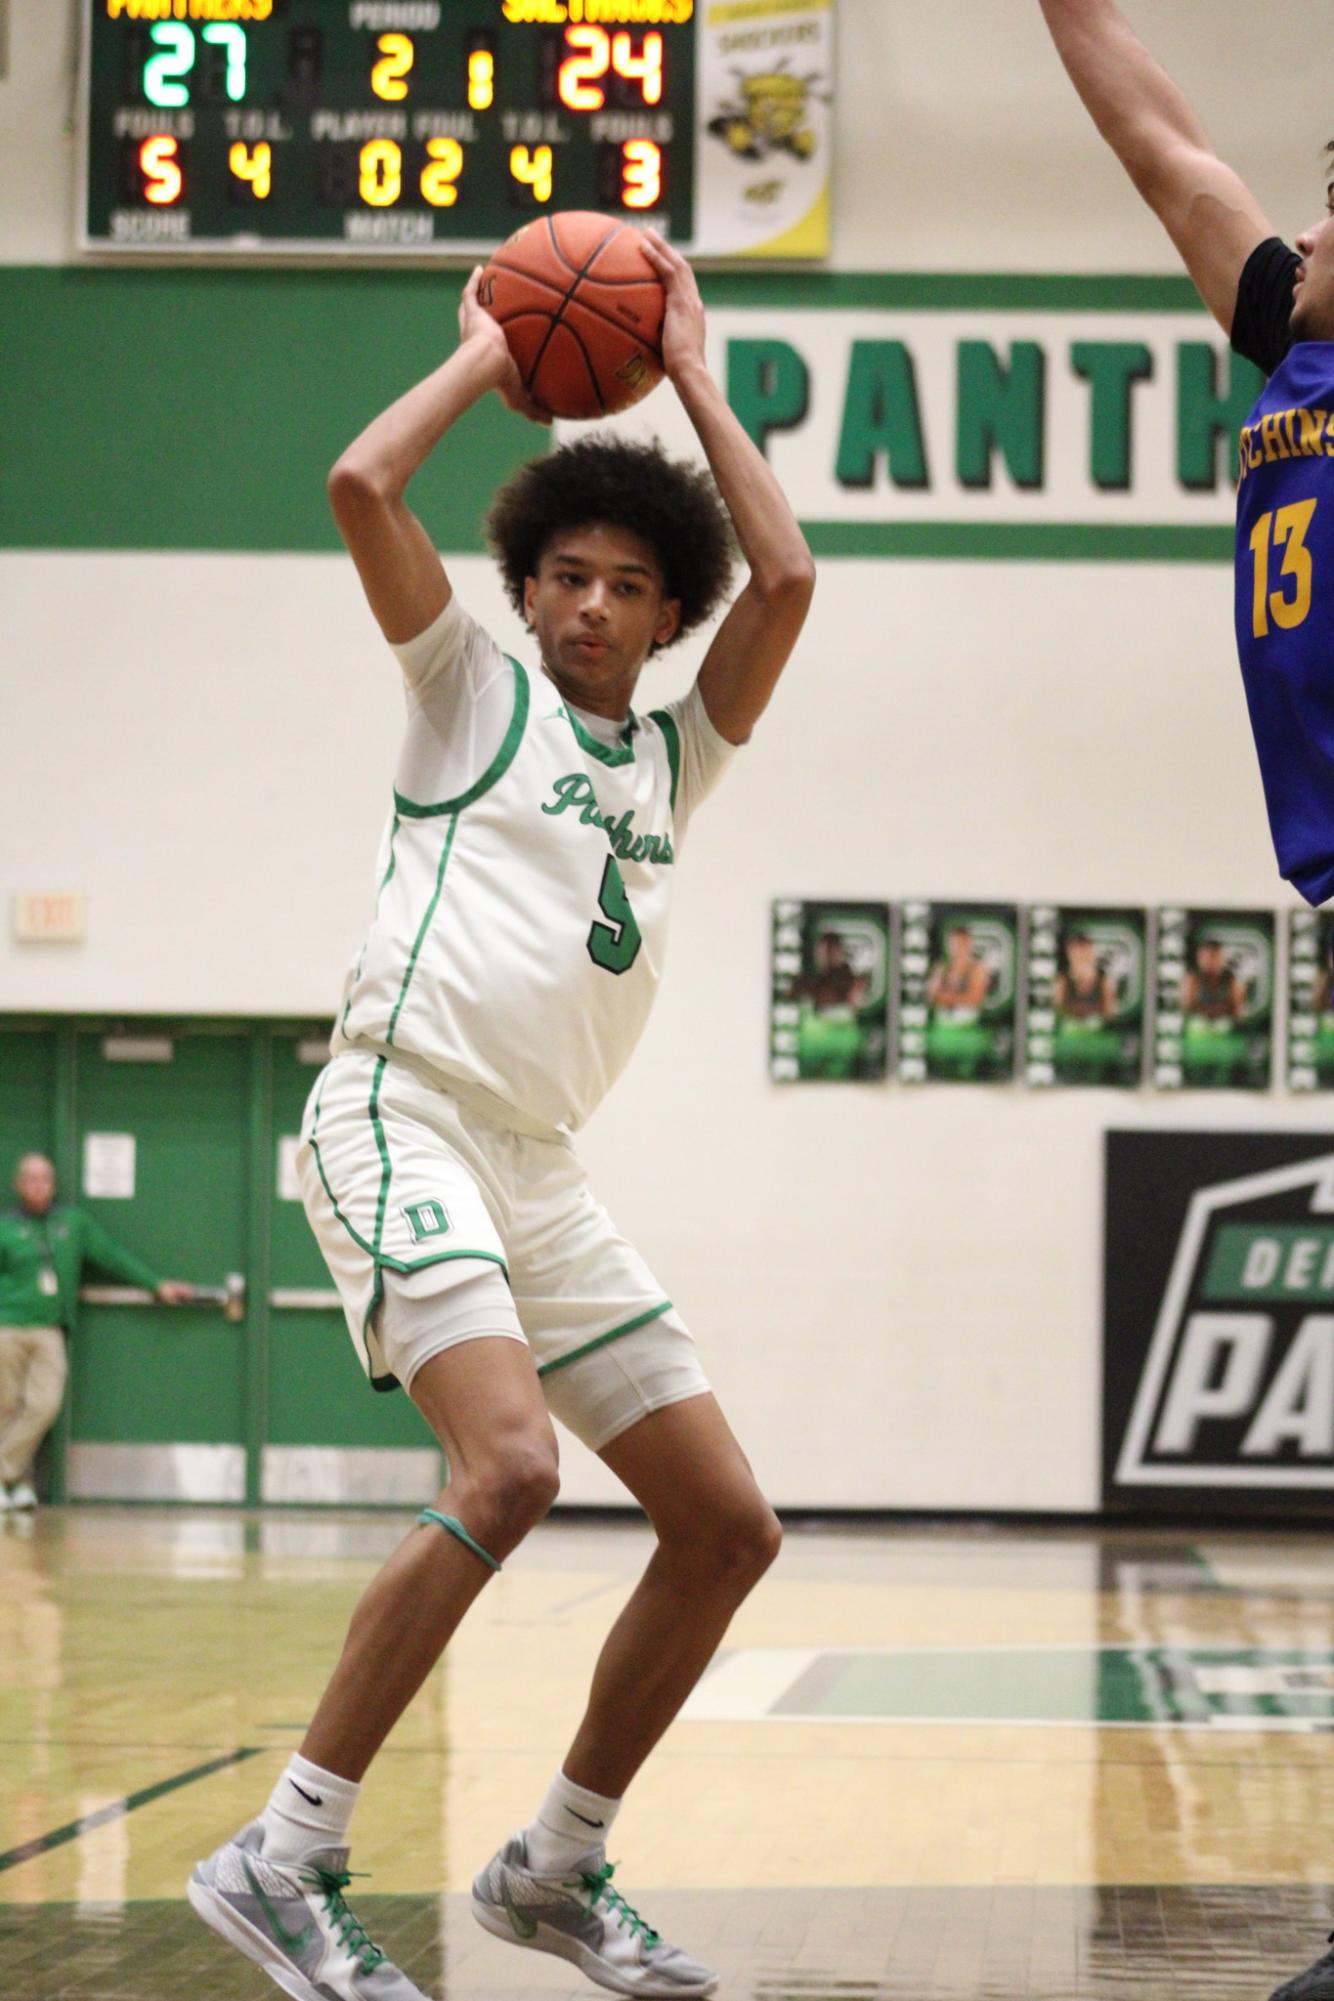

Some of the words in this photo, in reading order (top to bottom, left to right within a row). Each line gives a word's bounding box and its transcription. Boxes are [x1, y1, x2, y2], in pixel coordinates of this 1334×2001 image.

[143, 21, 247, 107] 27
[371, 33, 414, 101] 2
[558, 24, 663, 111] 24
[140, 134, 182, 204] 5
[229, 142, 271, 199] 4
[510, 145, 552, 202] 4
[621, 138, 661, 208] 3
[1249, 497, 1318, 639] 13
[586, 853, 642, 976] 5
[402, 1197, 454, 1245] D
